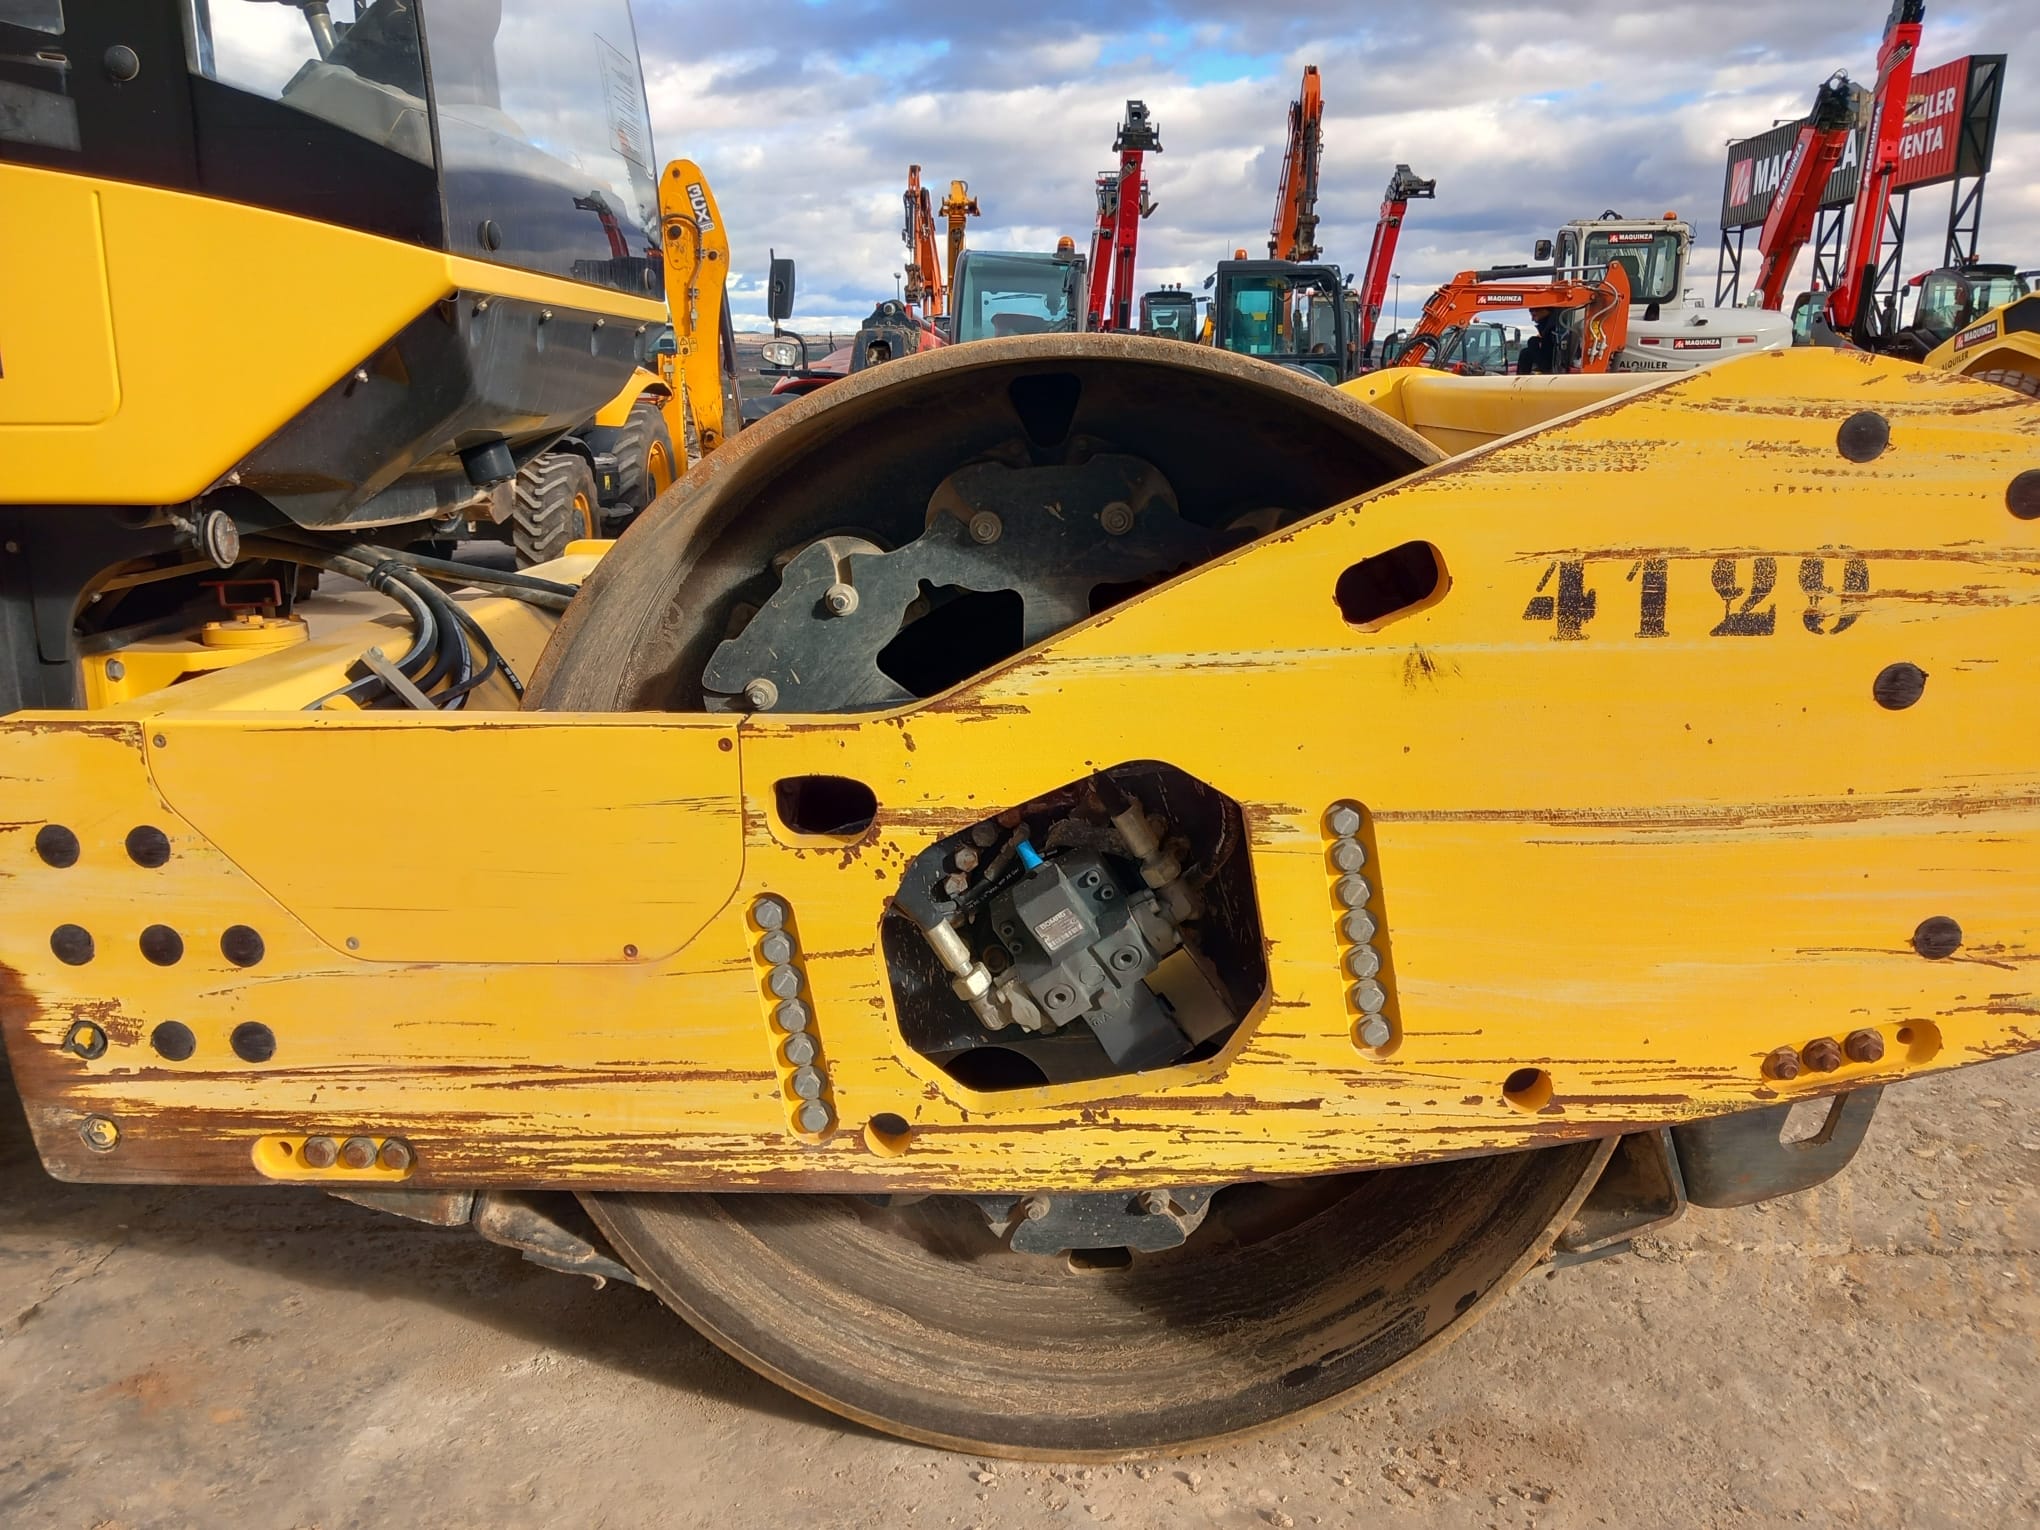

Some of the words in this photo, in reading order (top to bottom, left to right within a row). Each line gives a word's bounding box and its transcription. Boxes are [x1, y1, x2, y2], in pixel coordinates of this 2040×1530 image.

[1780, 143, 1804, 195] MAQUINZA
[687, 184, 711, 222] 3CX
[1619, 233, 1653, 241] MAQUINZA
[1963, 322, 1997, 342] MAQUINZA
[1684, 339, 1720, 347] MAQUINZA
[1619, 361, 1668, 370] ALQUILER
